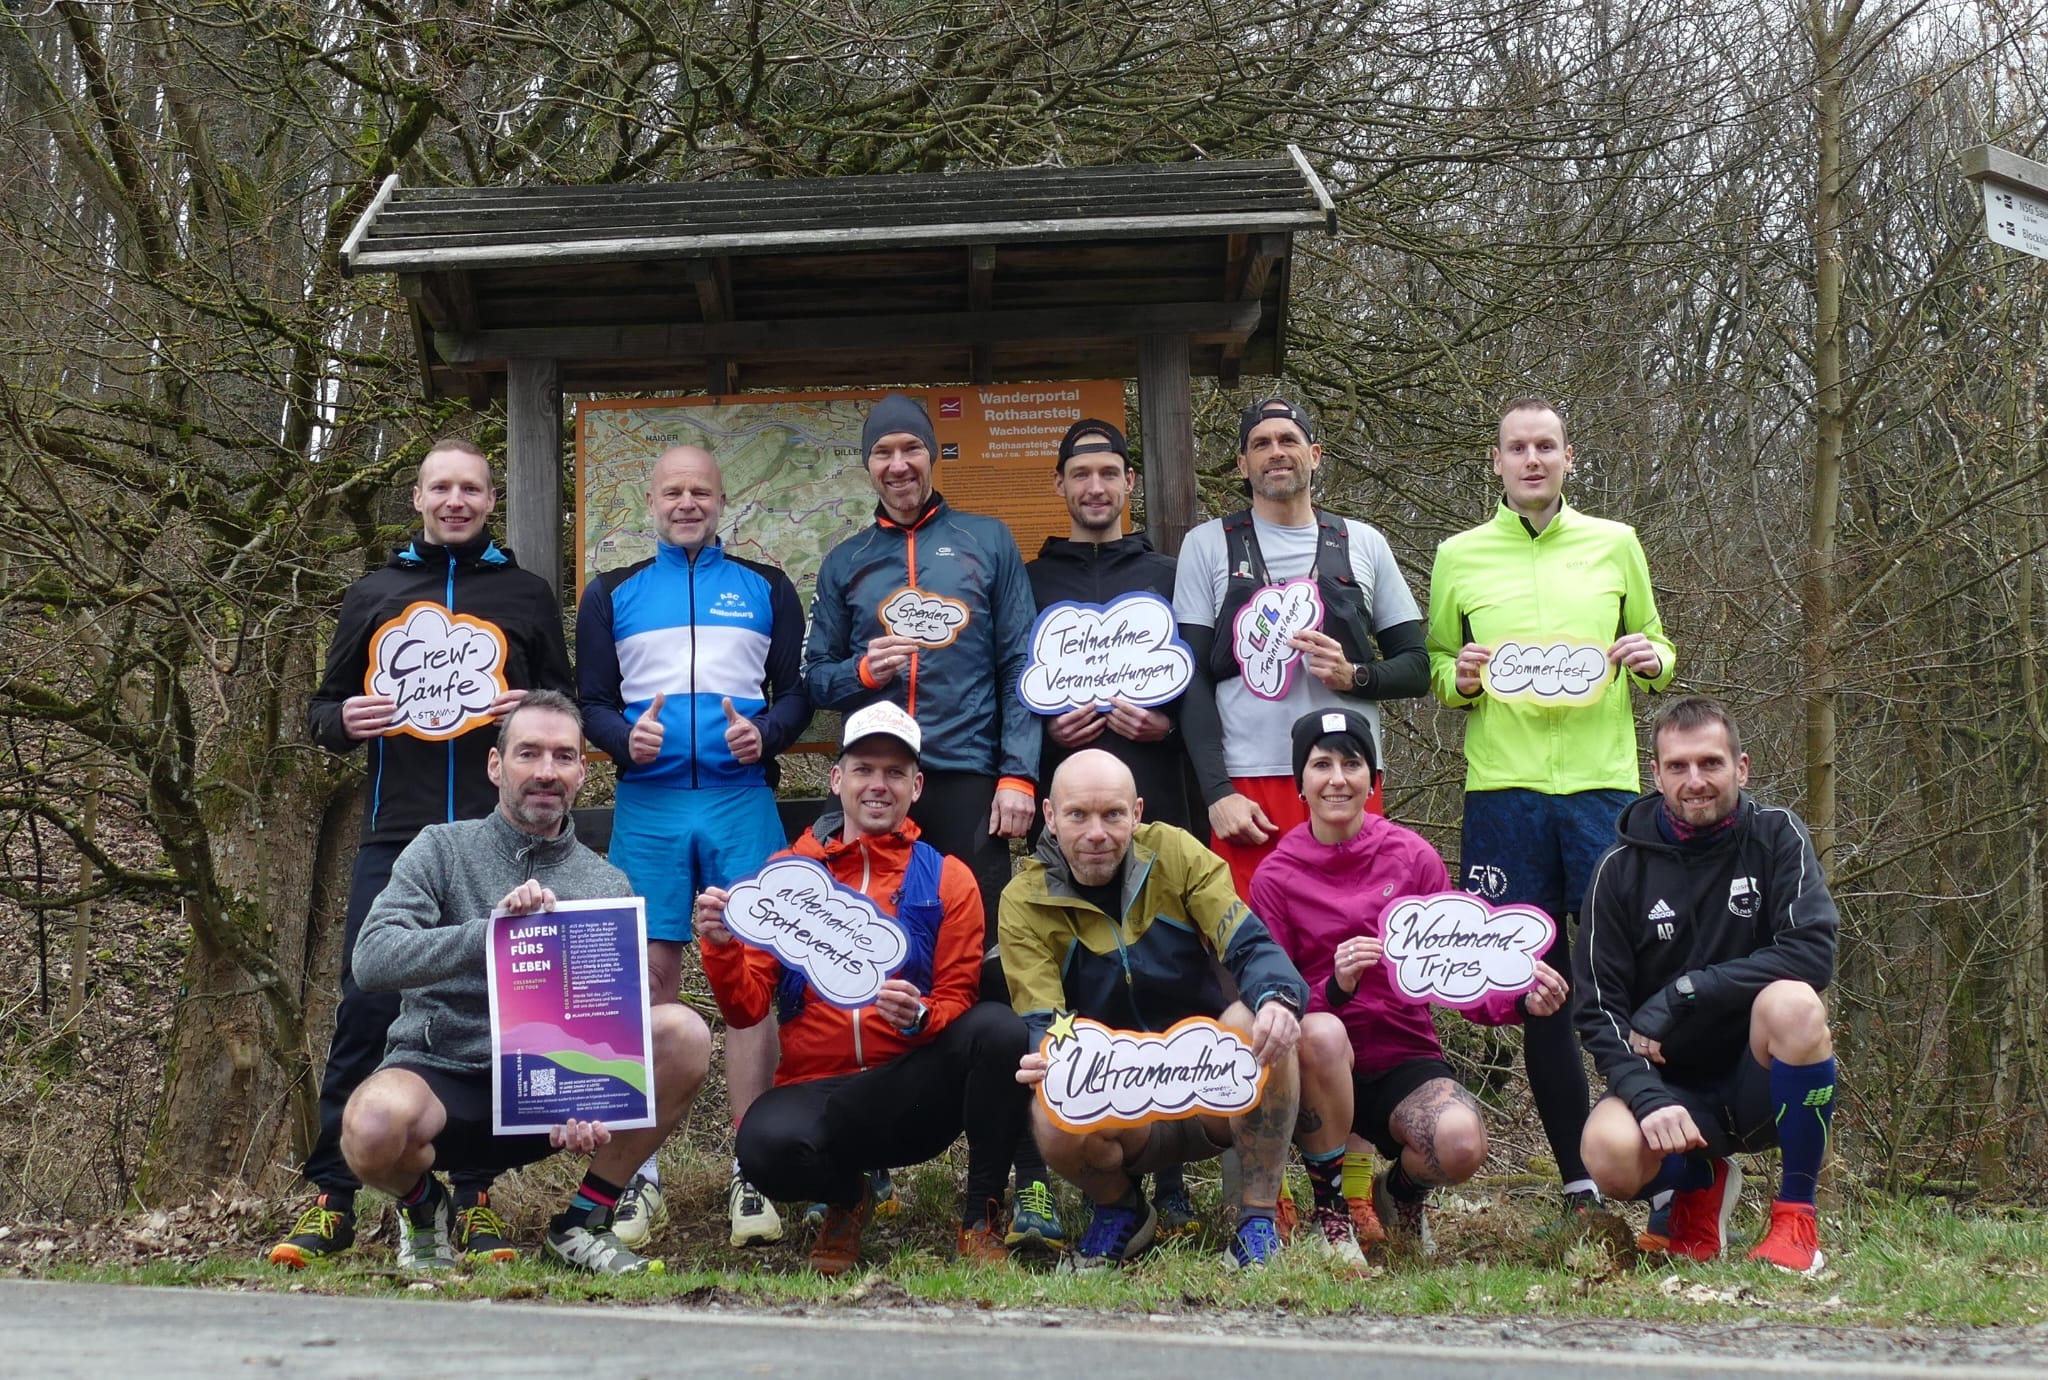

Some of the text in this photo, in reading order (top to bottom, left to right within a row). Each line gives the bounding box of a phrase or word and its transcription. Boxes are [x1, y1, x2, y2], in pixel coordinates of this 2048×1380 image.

[979, 389, 1080, 404] Wanderportal
[984, 407, 1080, 421] Rothaarsteig
[710, 608, 753, 618] Dillenburg
[898, 603, 949, 620] Spenden
[1051, 620, 1153, 657] Teilnahme
[1248, 604, 1280, 652] LFL
[1260, 596, 1300, 674] Trainingslager
[390, 640, 478, 679] Crew-
[1086, 653, 1109, 665] an
[1500, 655, 1590, 680] Sommerfest
[397, 670, 480, 708] Läufe
[1046, 663, 1174, 691] Veranstaltungen
[776, 888, 875, 952] alternative
[1648, 910, 1675, 920] adidas
[510, 925, 557, 940] LAUFEN
[749, 898, 864, 975] Sportevents
[1402, 912, 1526, 950] Wochenend-
[1657, 923, 1674, 941] AP
[511, 942, 544, 956] FÜRS
[512, 960, 551, 973] LEBEN
[1417, 954, 1482, 986] Trips
[1066, 1044, 1238, 1098] Ultramarathon
